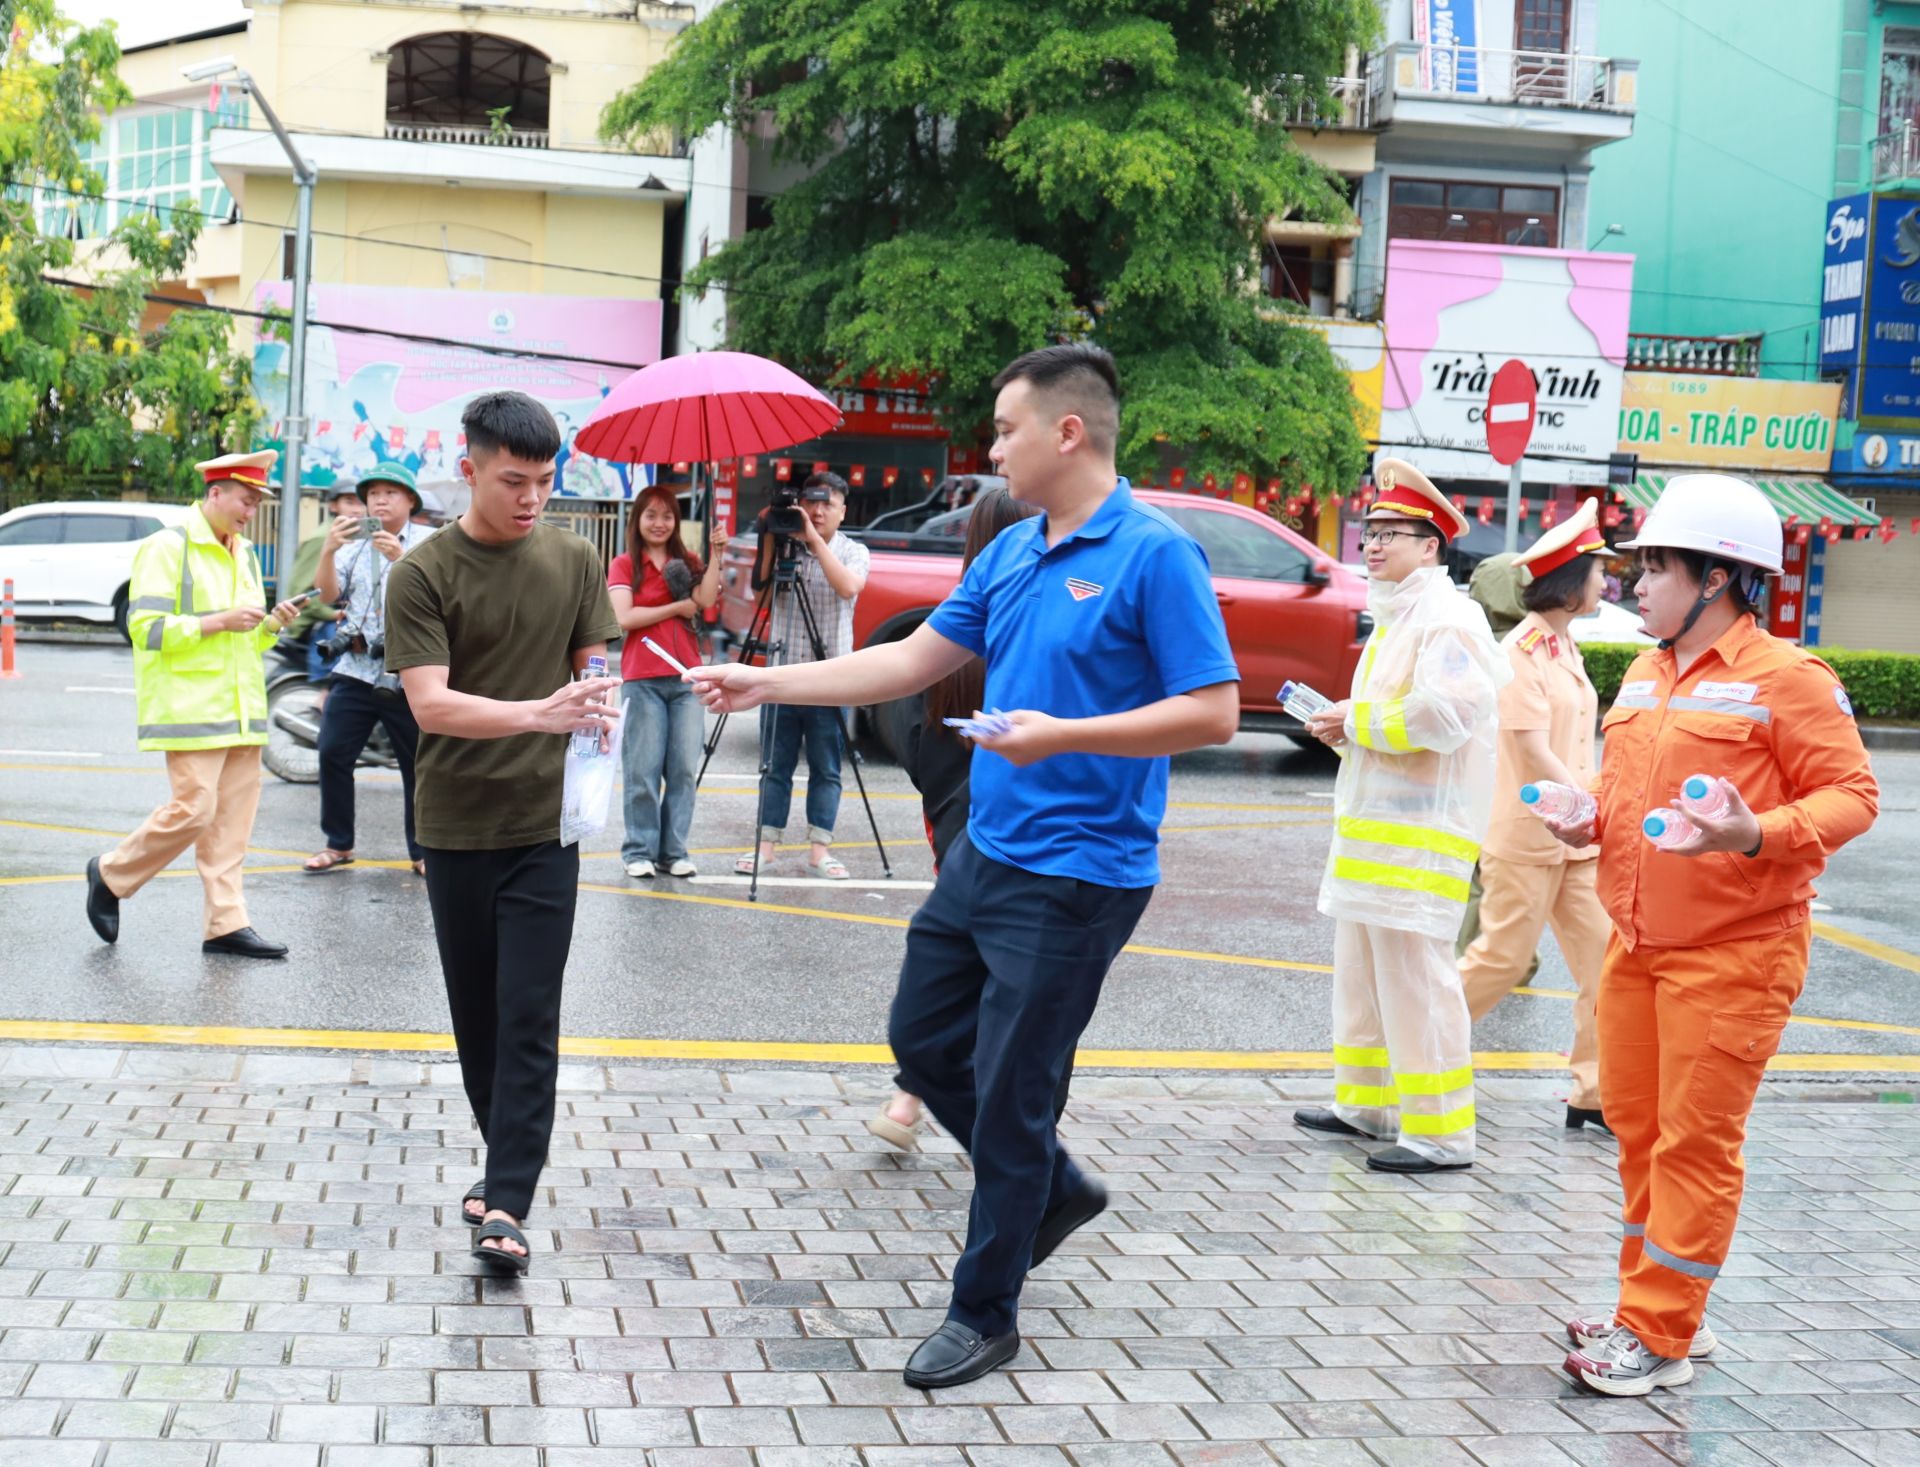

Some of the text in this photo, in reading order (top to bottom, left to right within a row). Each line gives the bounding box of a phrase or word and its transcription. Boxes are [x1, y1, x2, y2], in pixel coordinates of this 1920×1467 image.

[1826, 205, 1866, 254] Spa
[1824, 260, 1864, 303] THANH
[1823, 312, 1857, 354] LOAN
[1433, 352, 1494, 393] Trầ
[1670, 381, 1708, 394] 1989
[1689, 407, 1758, 446] TRÁP
[1765, 412, 1830, 452] CƯỚI
